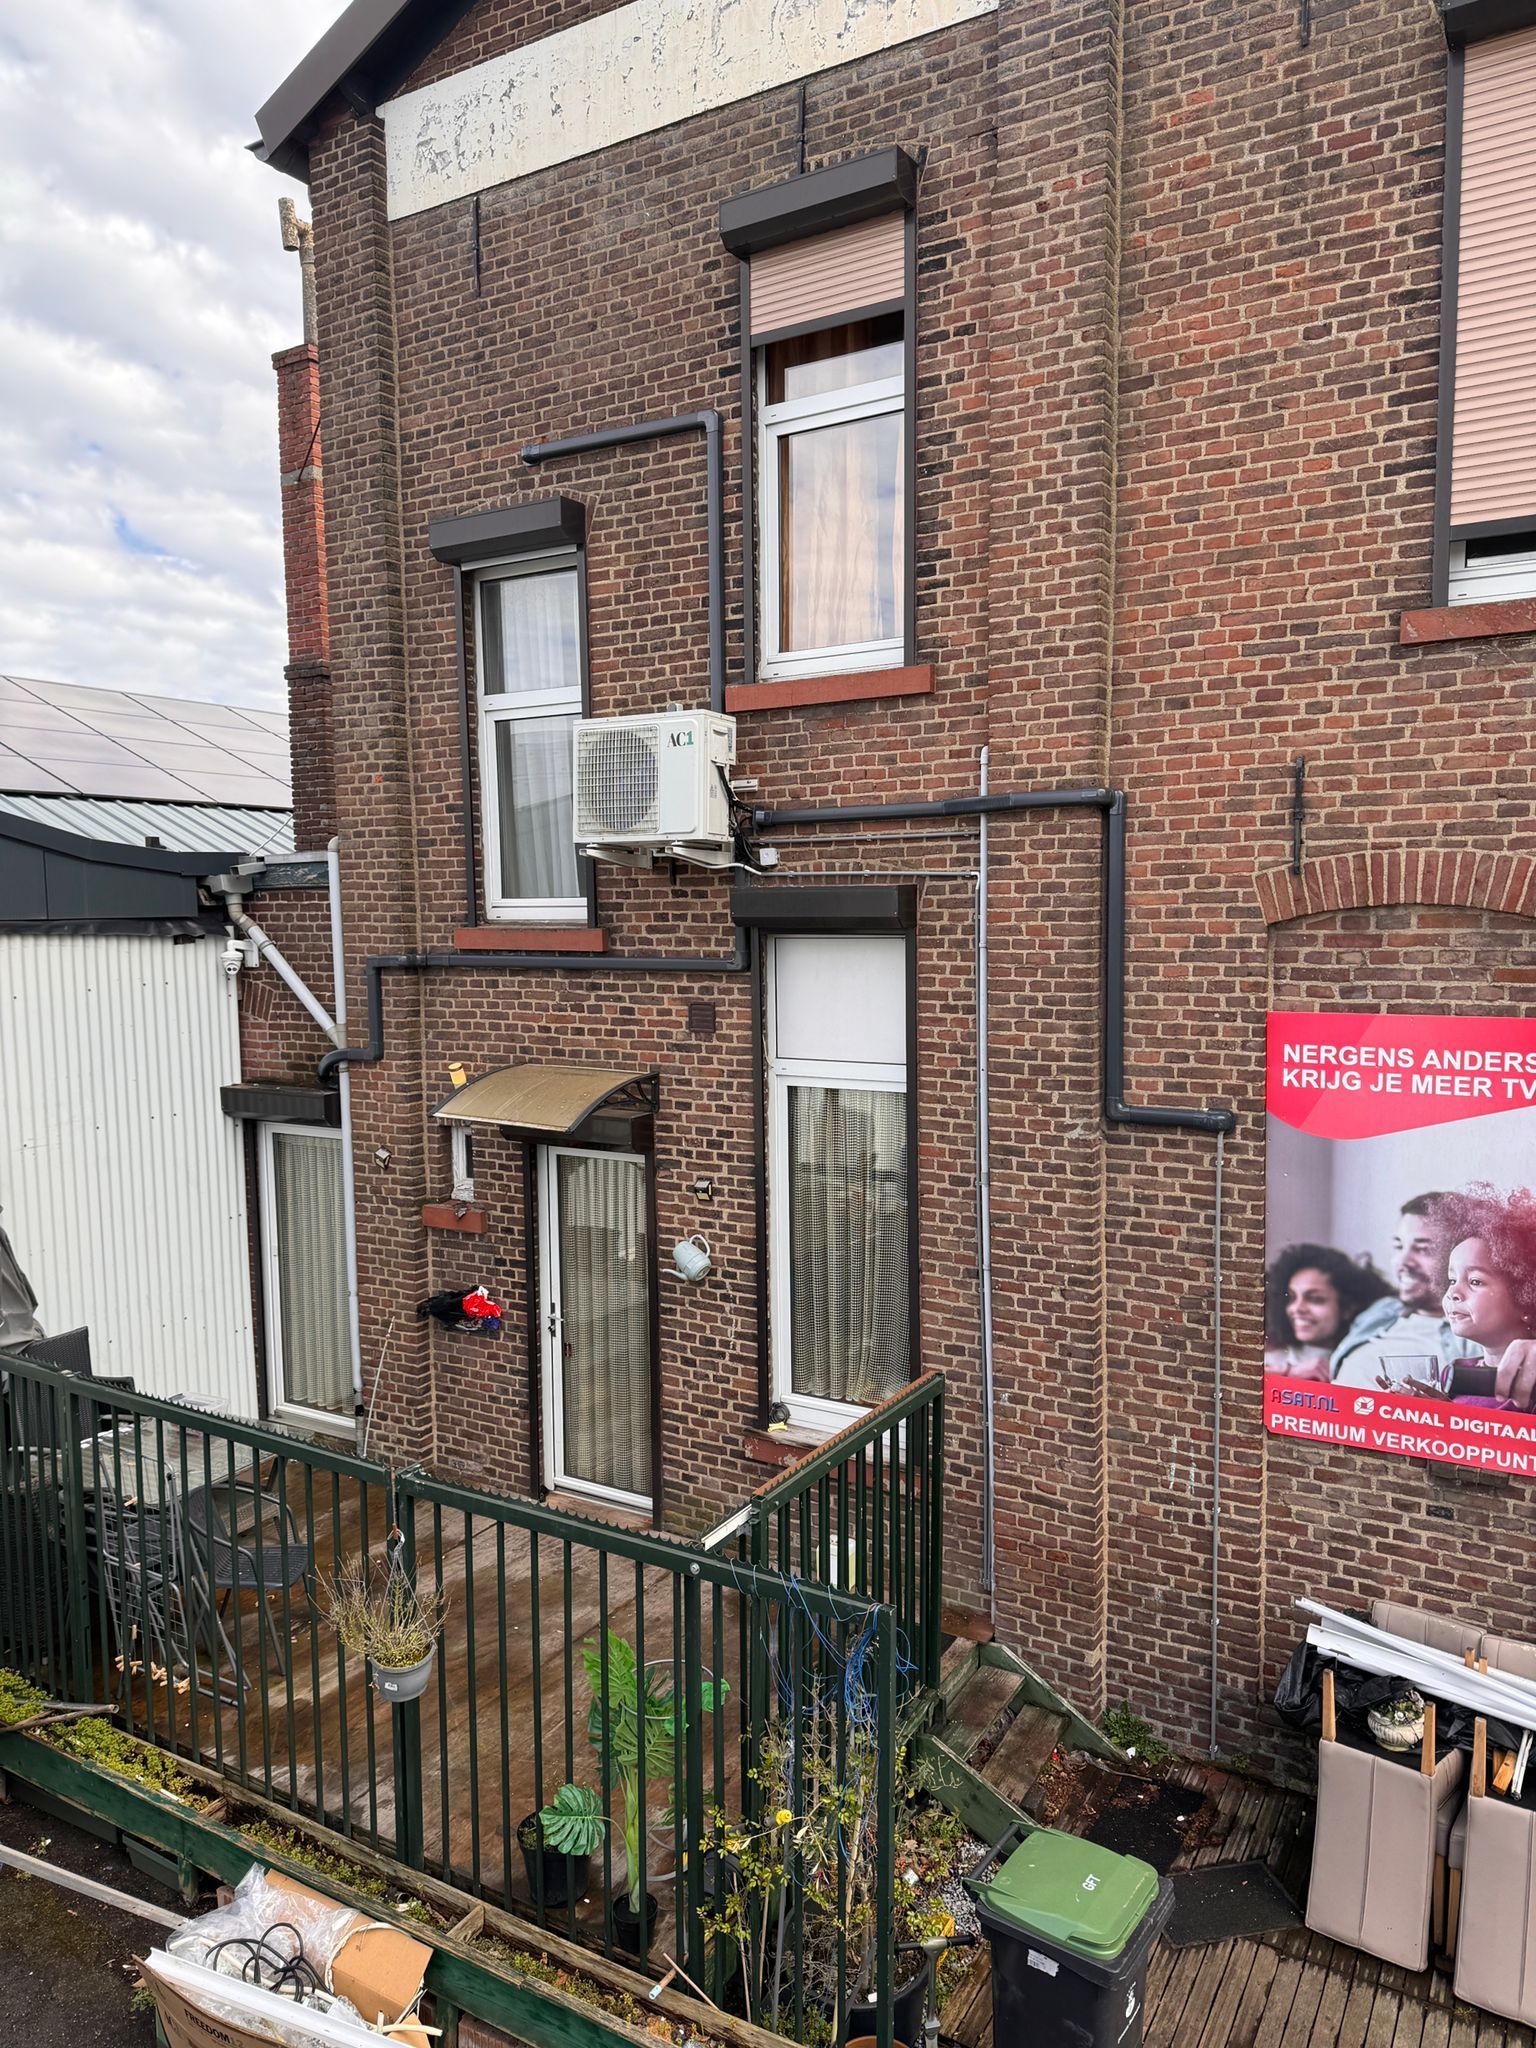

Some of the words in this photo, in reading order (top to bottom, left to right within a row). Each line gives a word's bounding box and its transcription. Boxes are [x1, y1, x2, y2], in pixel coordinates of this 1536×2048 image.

[666, 730, 694, 748] AC1
[1283, 1043, 1414, 1068] NERGENS
[1421, 1049, 1536, 1073] ANDERS
[1282, 1068, 1361, 1090] KRIJG
[1369, 1072, 1402, 1092] JE
[1412, 1074, 1493, 1097] MEER
[1501, 1078, 1536, 1100] TV
[1271, 1413, 1366, 1442] PREMIUM
[1379, 1405, 1444, 1428] CANAL
[1082, 1873, 1101, 1891] GFT
